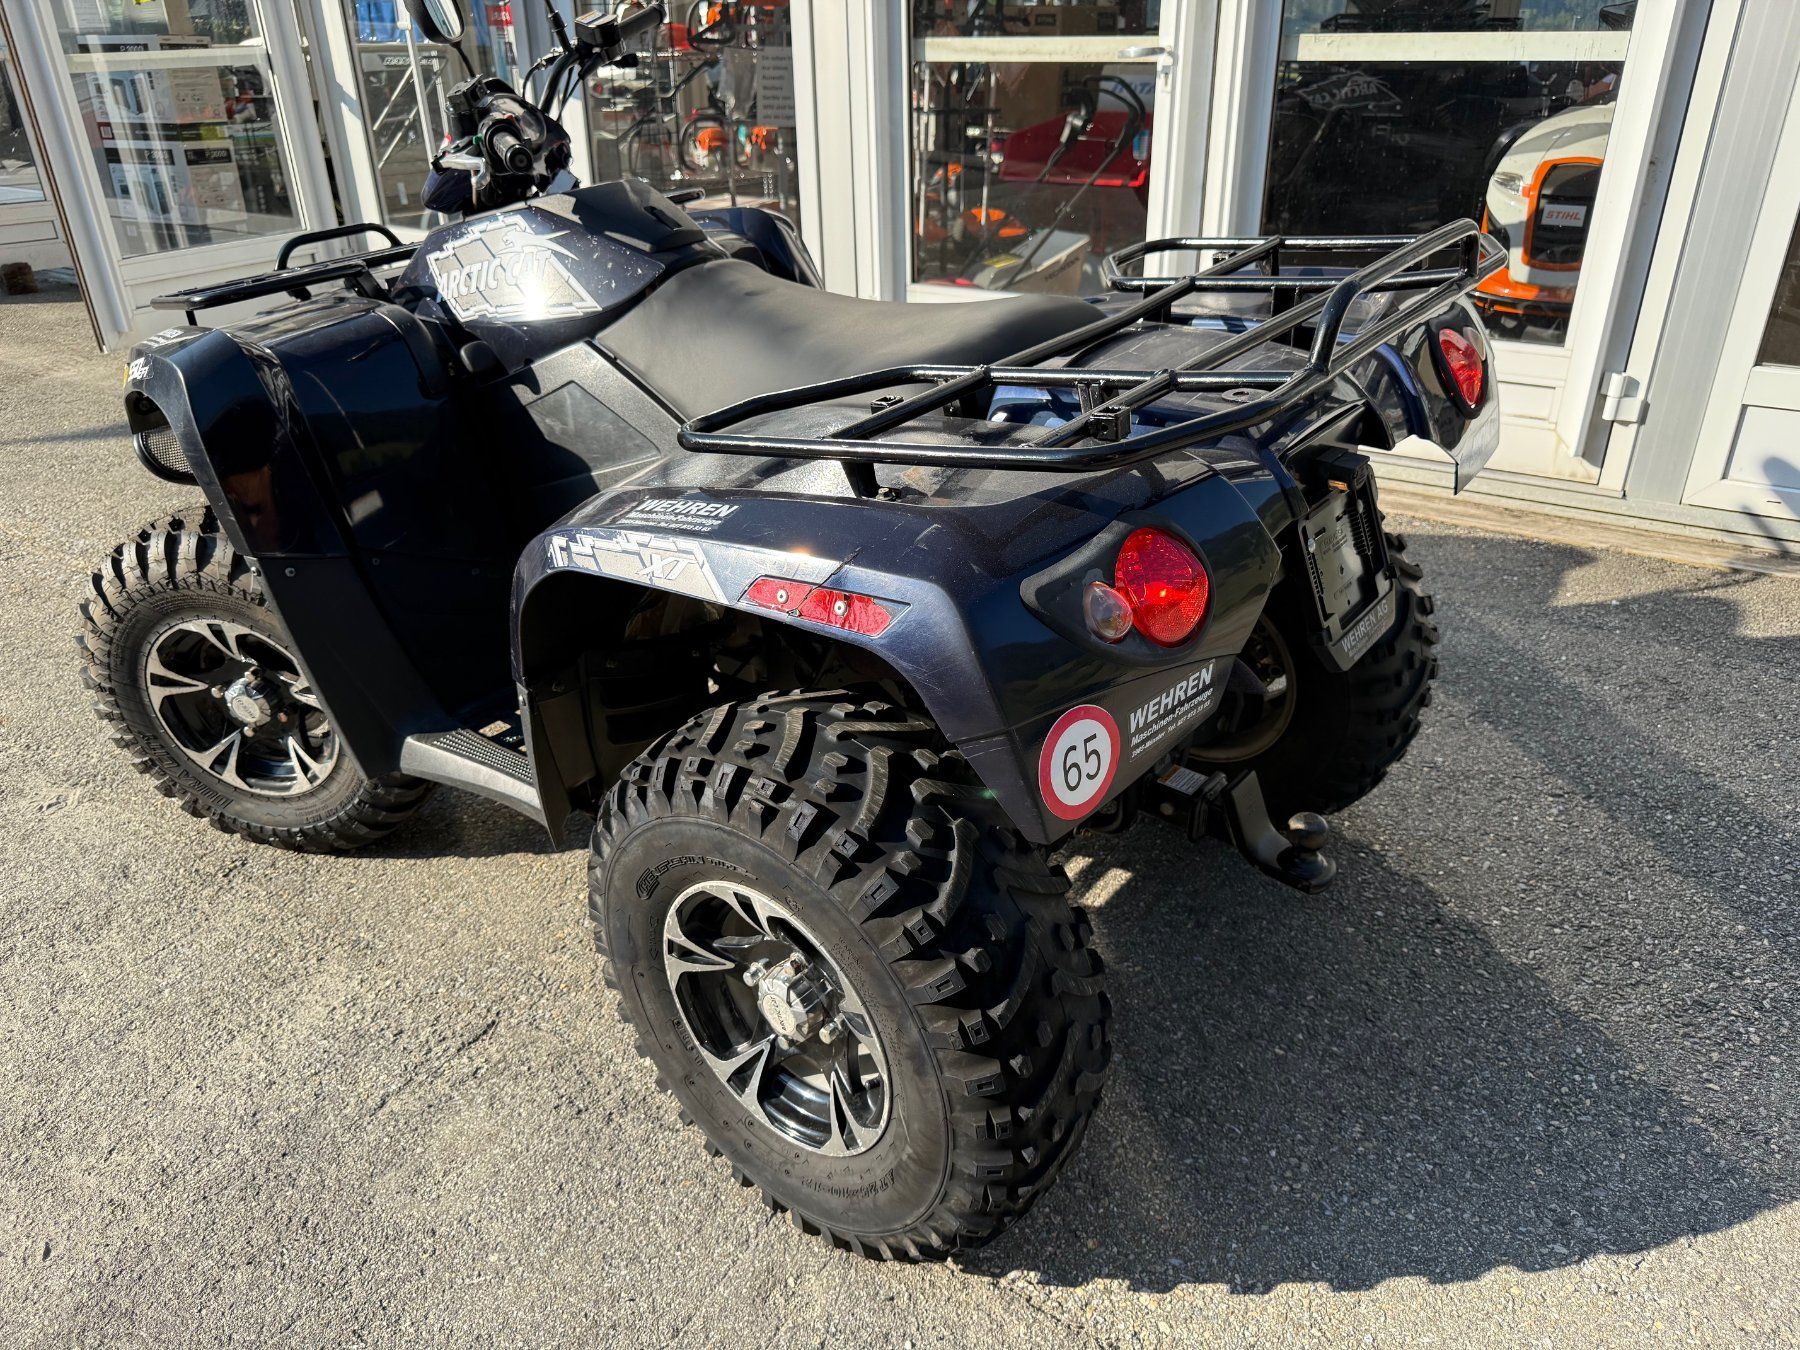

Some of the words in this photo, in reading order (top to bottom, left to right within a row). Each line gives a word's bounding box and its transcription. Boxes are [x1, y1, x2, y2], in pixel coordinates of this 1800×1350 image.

[1545, 211, 1581, 221] STIHL
[439, 257, 501, 300] ARCTIC
[505, 247, 552, 288] CAT
[632, 499, 740, 518] WEHREN
[636, 554, 698, 580] XT
[1341, 611, 1377, 652] WEHREN
[1376, 600, 1388, 621] AG
[1130, 663, 1214, 734] WEHREN
[1131, 688, 1214, 748] Maschinen-Fahrzeuge
[1062, 732, 1102, 792] 65
